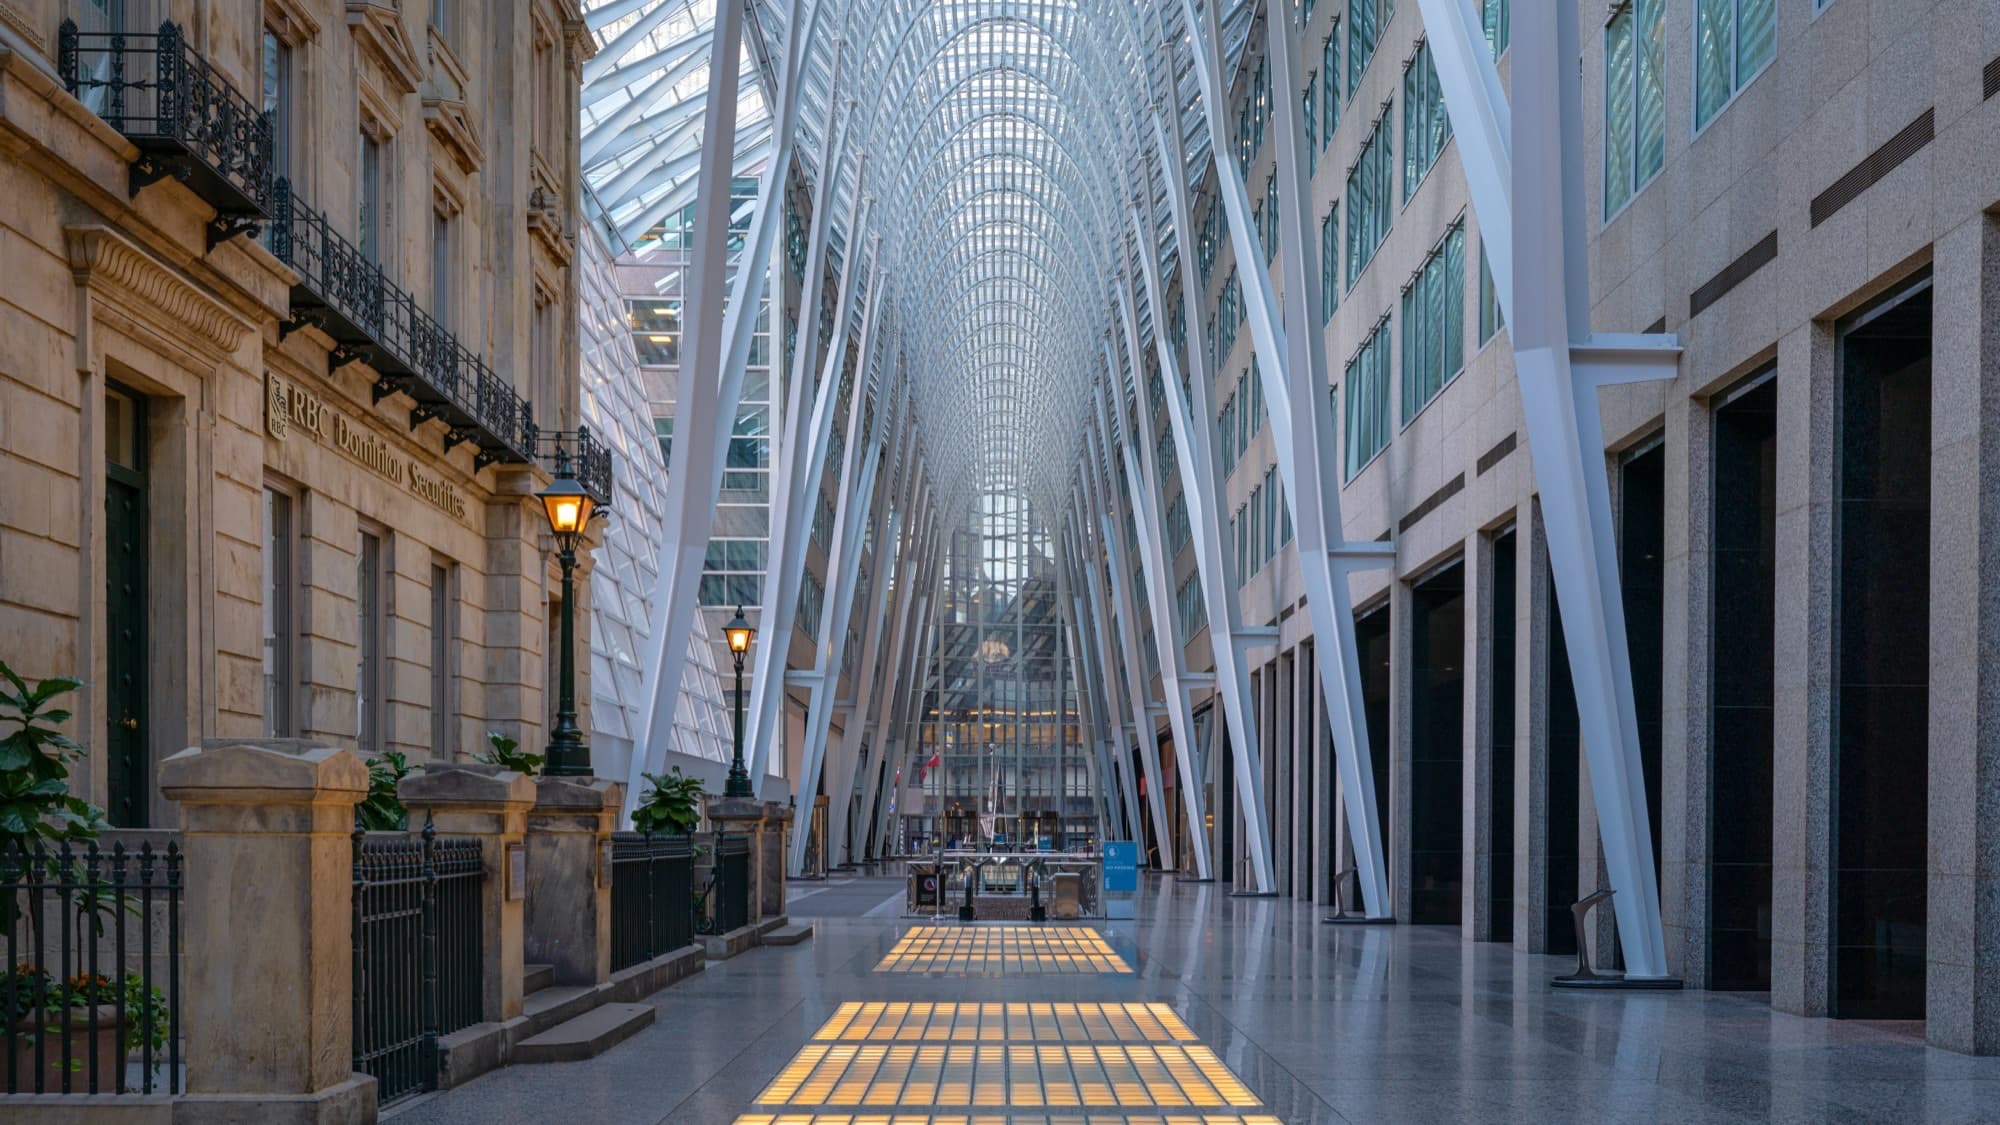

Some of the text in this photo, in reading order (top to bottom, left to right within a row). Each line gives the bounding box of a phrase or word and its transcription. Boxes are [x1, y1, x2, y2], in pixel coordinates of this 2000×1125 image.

[271, 418, 287, 438] RBC
[292, 386, 465, 518] RBC Dominion Securities
